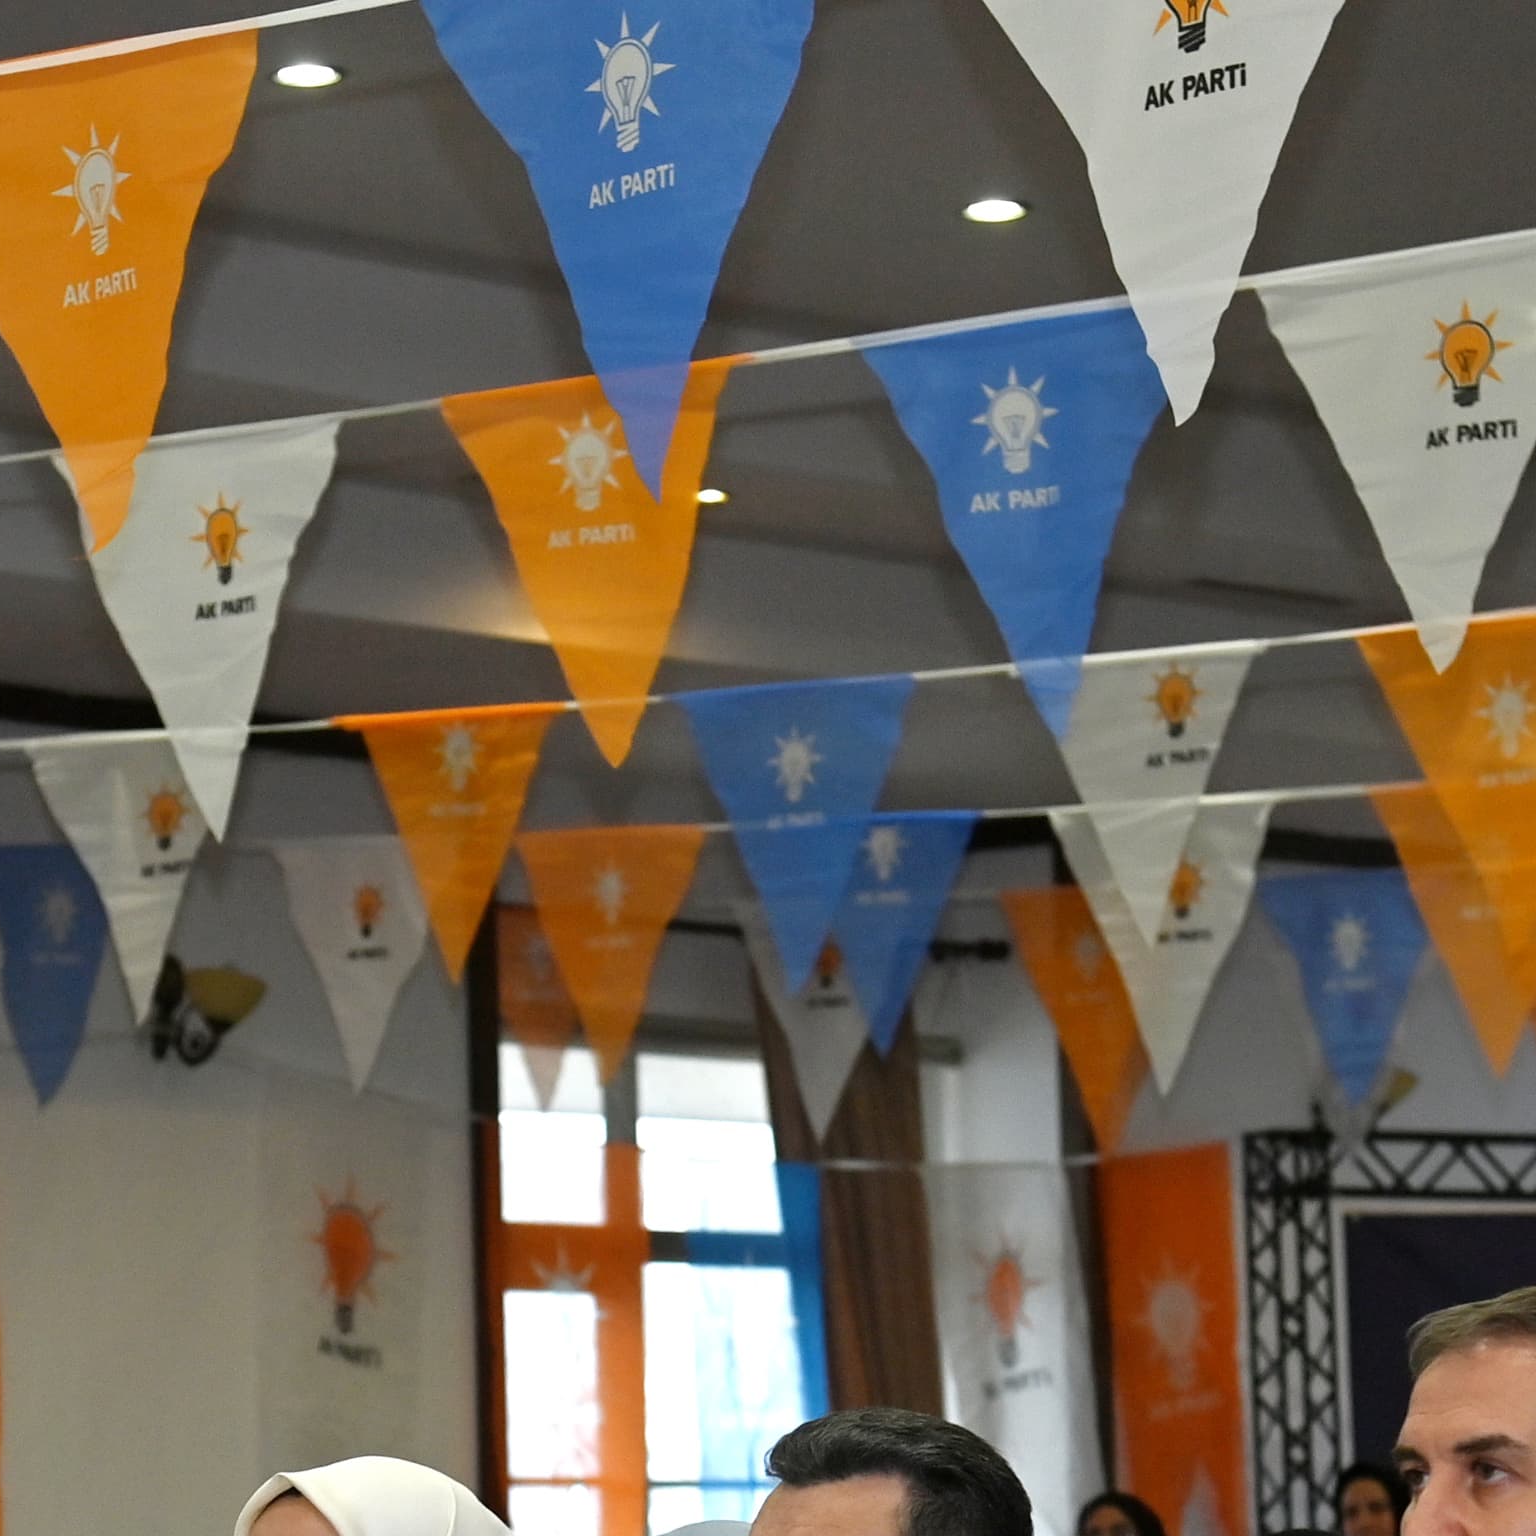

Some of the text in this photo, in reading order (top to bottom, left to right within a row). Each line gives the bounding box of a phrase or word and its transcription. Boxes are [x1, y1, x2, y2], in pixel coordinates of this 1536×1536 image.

[1144, 82, 1174, 111] AK
[588, 181, 615, 209] AK
[63, 284, 91, 309] AK
[1426, 427, 1448, 451] AK
[970, 493, 1002, 513] AK
[547, 529, 573, 548] AK
[195, 602, 216, 621] AK
